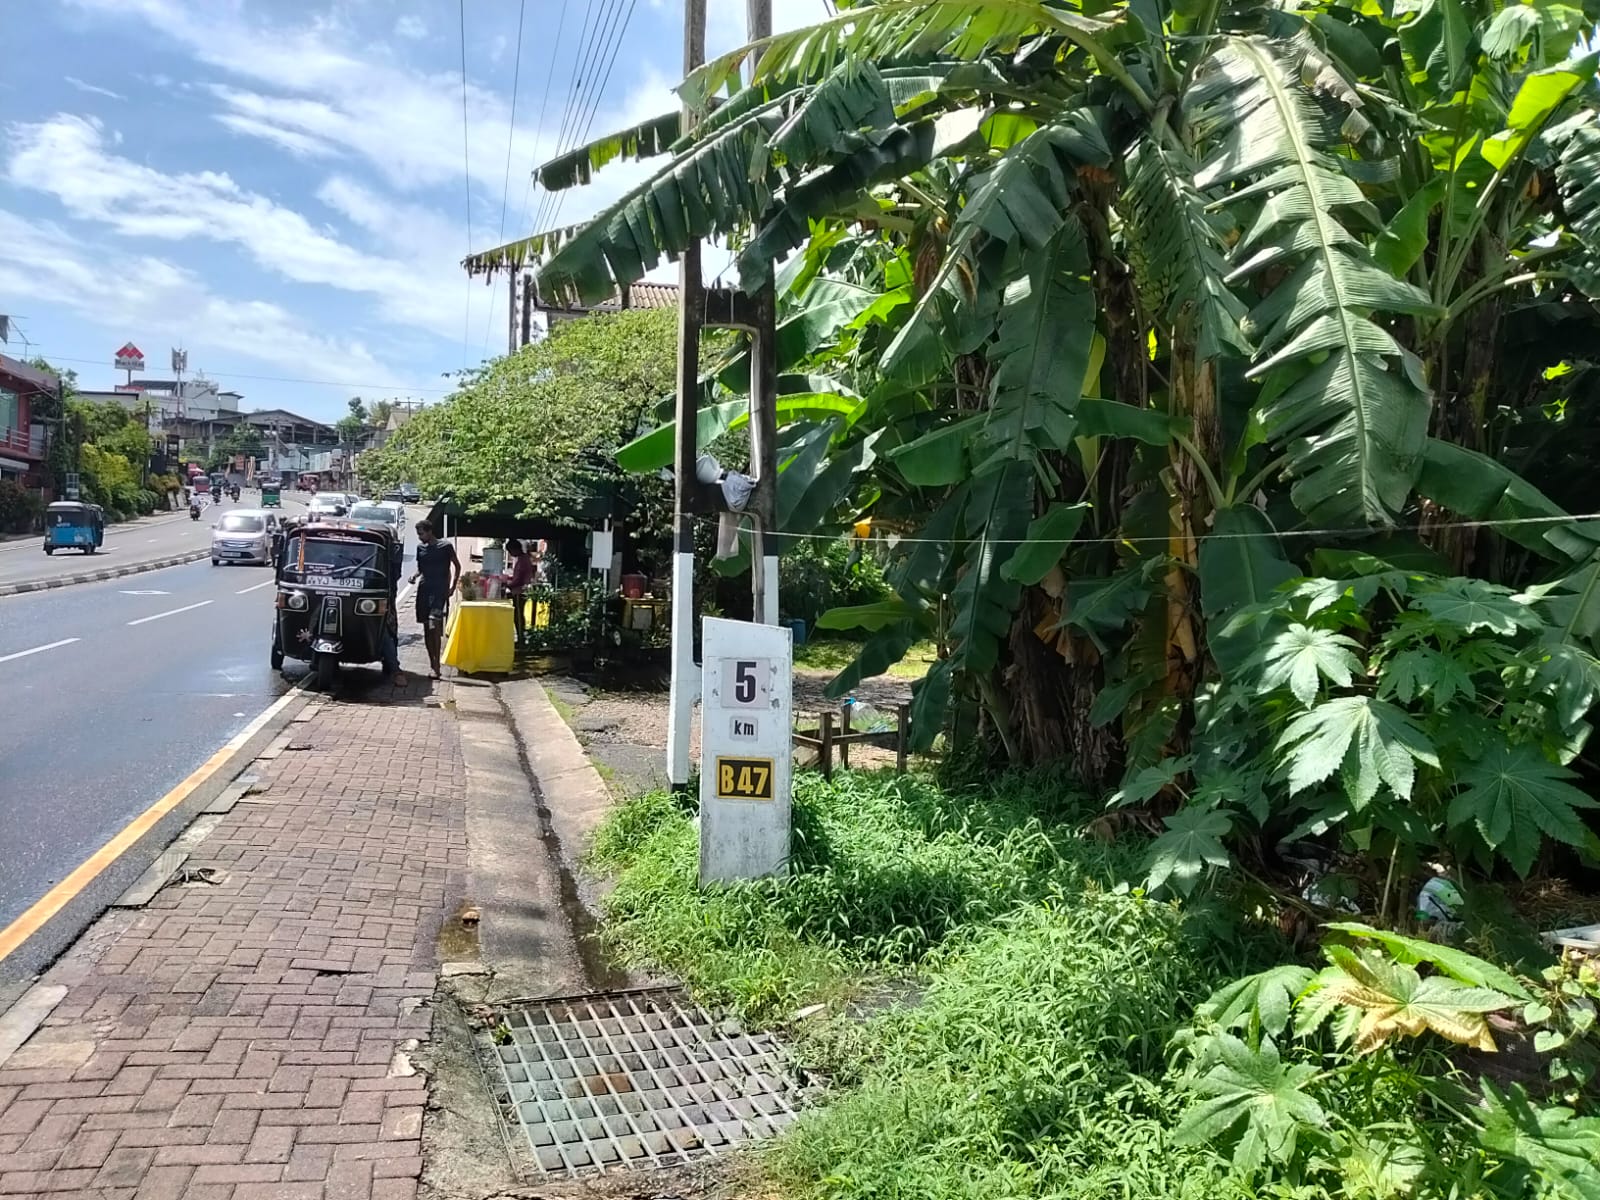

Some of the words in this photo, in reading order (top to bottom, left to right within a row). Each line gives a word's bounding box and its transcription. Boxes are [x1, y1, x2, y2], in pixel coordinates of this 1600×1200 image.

[735, 661, 757, 703] 5
[734, 720, 754, 736] km
[721, 764, 769, 795] B47
